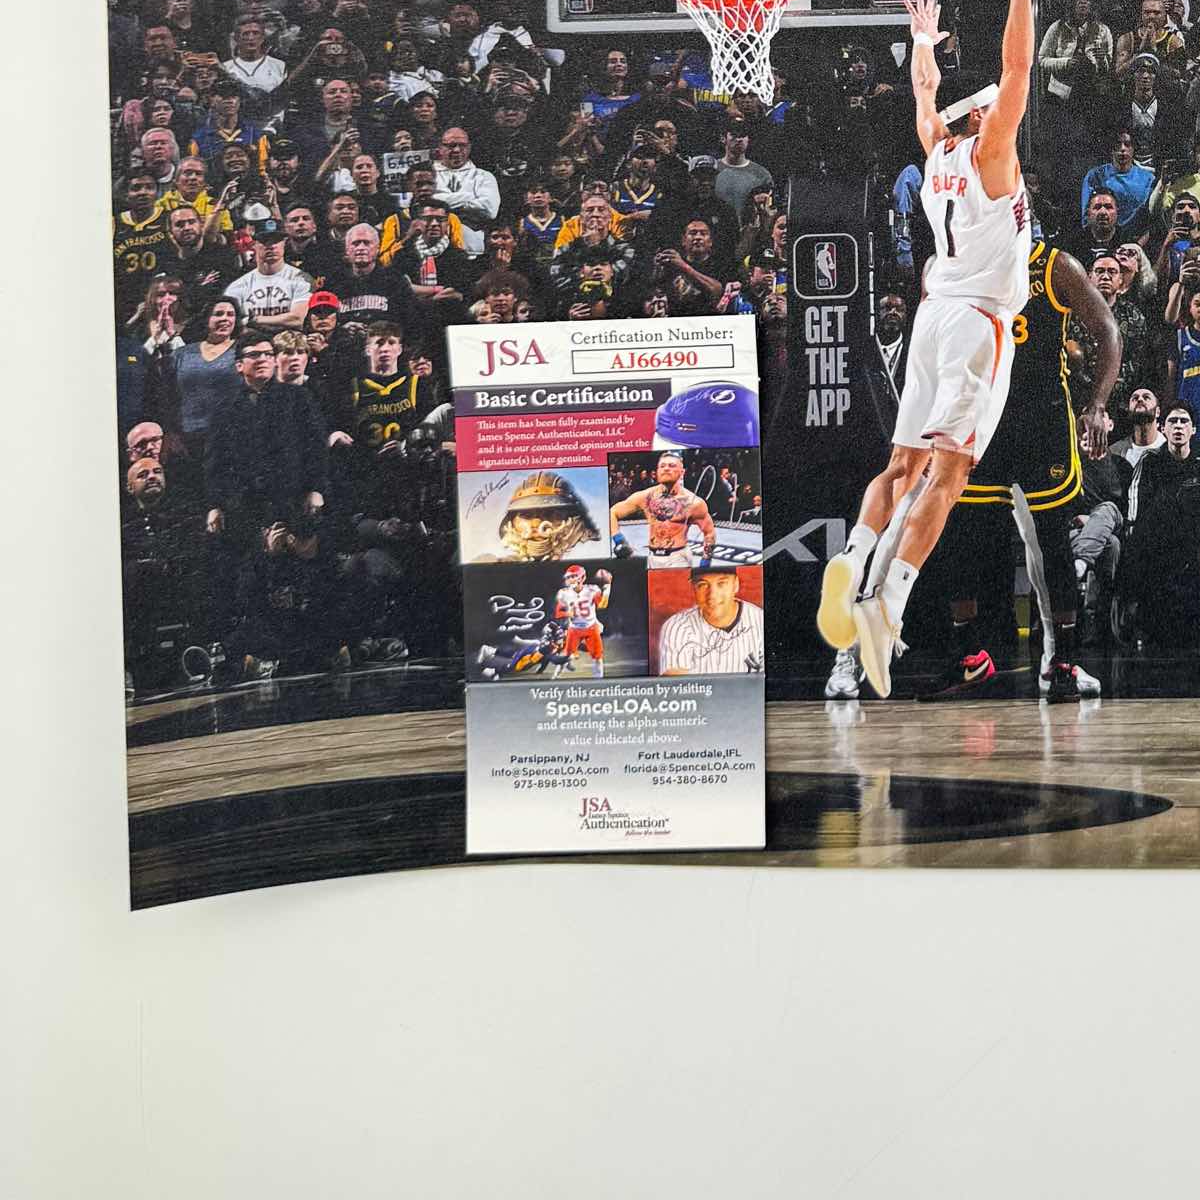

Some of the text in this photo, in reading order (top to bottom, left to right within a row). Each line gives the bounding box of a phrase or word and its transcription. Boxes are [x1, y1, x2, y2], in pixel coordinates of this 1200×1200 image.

[944, 199, 956, 257] 1
[127, 252, 157, 272] 30
[805, 305, 848, 344] GET
[571, 327, 734, 345] Certification Number:
[480, 339, 550, 376] JSA
[610, 351, 698, 369] AJ66490
[805, 347, 850, 385] THE
[476, 386, 654, 408] Basic Certification
[805, 388, 850, 426] APP
[478, 414, 635, 430] This item has been fully examined by
[477, 426, 625, 443] James Spence Authentication, LLC
[478, 444, 495, 454] and
[505, 443, 513, 453] is
[514, 444, 529, 452] our
[532, 441, 578, 451] considered
[580, 439, 614, 452] opinion
[616, 438, 633, 448] that
[634, 437, 650, 447] the
[479, 454, 595, 468] signature(s) is/are genuine.
[530, 683, 713, 700] Verify this certification by visiting
[546, 699, 697, 718] SpenceLOA.com
[536, 715, 708, 731] and entering the alpha-numeric
[563, 732, 682, 745] value indicated above.
[510, 753, 590, 765] Parsippany, NJ
[638, 751, 660, 760] Fort
[513, 778, 588, 789] 973-898-1300
[652, 774, 728, 785] 954-380-8670
[579, 797, 612, 817] JSA
